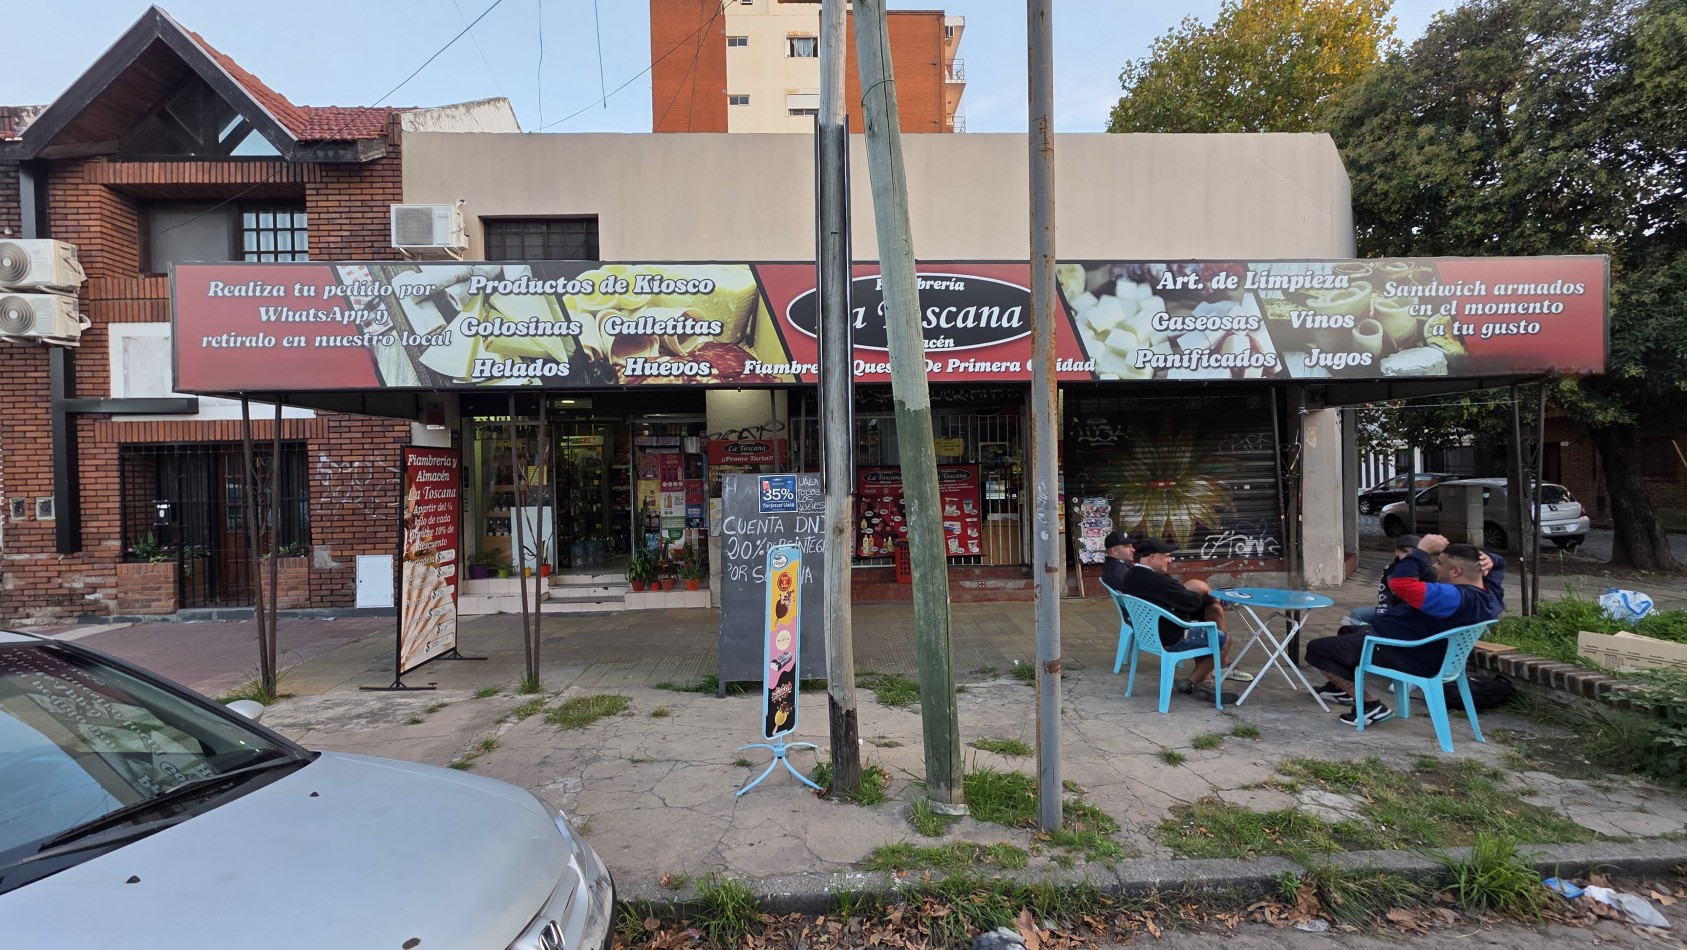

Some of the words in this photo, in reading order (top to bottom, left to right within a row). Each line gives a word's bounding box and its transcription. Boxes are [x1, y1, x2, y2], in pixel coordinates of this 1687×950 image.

[208, 281, 285, 297] Realiza
[294, 283, 316, 297] tu
[323, 281, 393, 300] pedido
[397, 284, 436, 300] por
[468, 276, 593, 295] Productos
[599, 276, 627, 294] de
[632, 275, 714, 294] Kiosco
[875, 278, 965, 291] Fbrería
[1156, 271, 1204, 290] Art.
[1211, 272, 1238, 290] de
[1243, 270, 1349, 293] Limpieza
[1384, 280, 1486, 297] Sandwich
[1494, 279, 1585, 295] armados
[259, 306, 368, 325] WhatsApp
[375, 310, 389, 325] y
[877, 300, 1023, 329] scana
[1408, 303, 1432, 316] en
[1440, 300, 1457, 316] el
[1464, 300, 1564, 315] momento
[460, 316, 582, 336] Golosinas
[604, 316, 722, 336] Galletitas
[1152, 312, 1261, 331] Gaseosas
[1289, 310, 1355, 329] Vinos
[1432, 324, 1445, 336] a
[1452, 320, 1474, 336] tu
[1480, 319, 1541, 340] gusto
[202, 332, 276, 347] retiralo
[282, 335, 306, 347] en
[314, 333, 395, 347] nuestro
[401, 331, 451, 347] local
[472, 359, 570, 377] Helados
[624, 357, 710, 376] Huevos
[743, 360, 818, 375] Fiambre
[854, 360, 892, 374] Ques
[925, 359, 942, 373] De
[946, 358, 1021, 373] Primera
[1134, 348, 1277, 370] Panificados
[1304, 348, 1372, 370] Jugos
[407, 454, 451, 466] Fiambrería
[452, 458, 457, 469] y
[416, 470, 450, 482] Almacén
[408, 487, 420, 501] La
[423, 486, 456, 499] Toscana
[763, 488, 793, 500] 35%
[437, 502, 447, 511] del
[427, 515, 435, 525] de
[436, 513, 451, 523] cada
[723, 516, 784, 534] CUENTA
[447, 525, 454, 533] de
[725, 536, 767, 560] 20%
